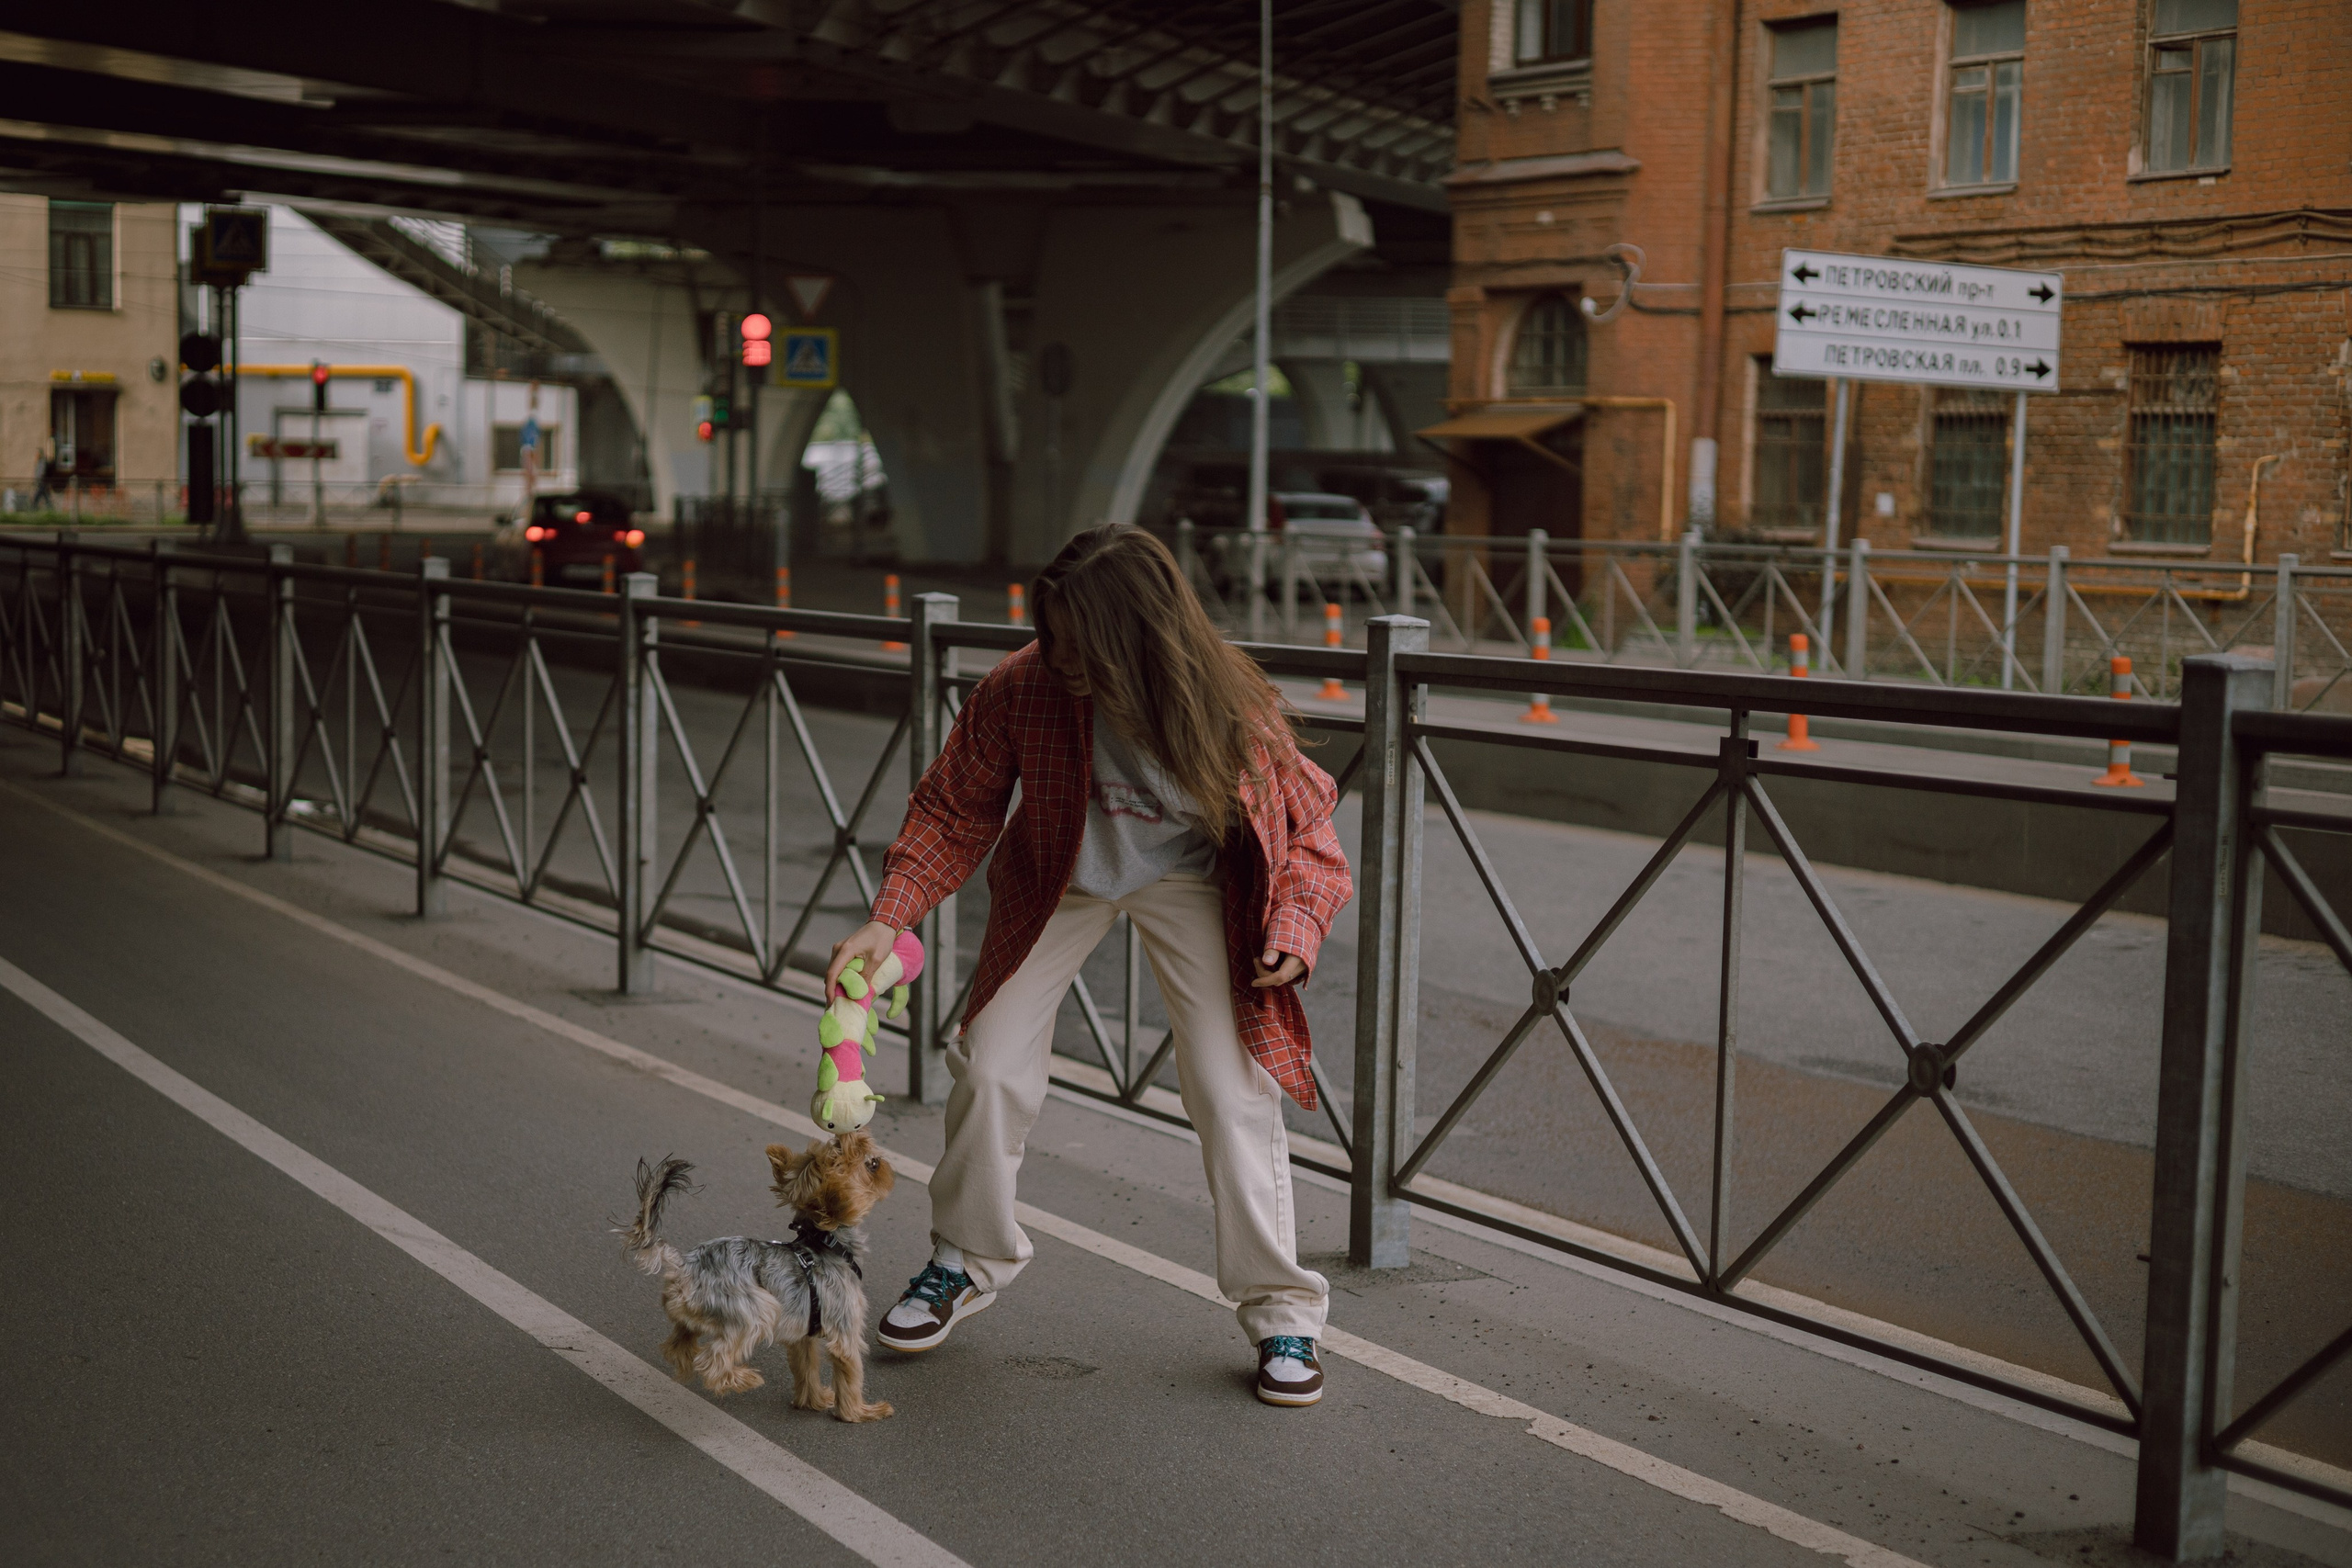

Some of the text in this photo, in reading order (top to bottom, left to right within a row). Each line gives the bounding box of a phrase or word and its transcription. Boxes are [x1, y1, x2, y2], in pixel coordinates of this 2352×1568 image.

[1825, 265, 1994, 300] ПЕТРОВСКИЙ пр-т
[1819, 304, 1966, 333] РЕМЕСЛЕННАЯ
[1825, 344, 1953, 371] ПЕТРОВСКАЯ
